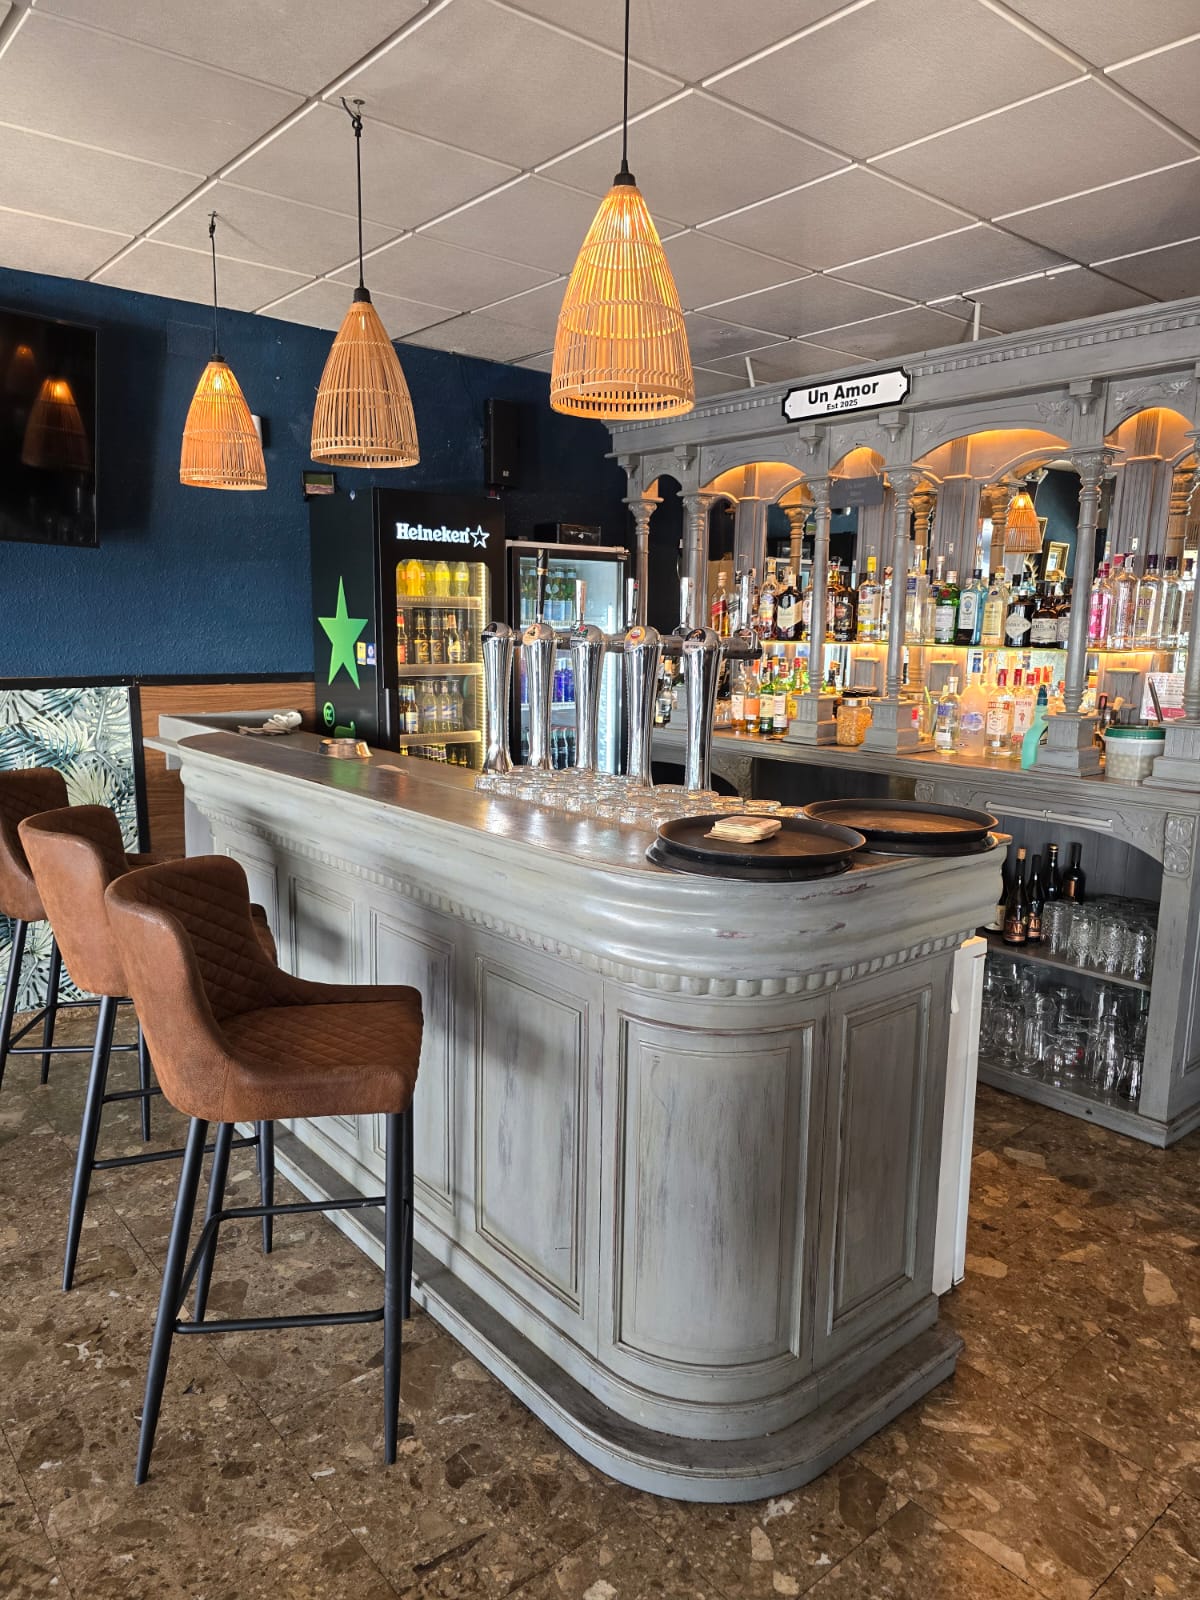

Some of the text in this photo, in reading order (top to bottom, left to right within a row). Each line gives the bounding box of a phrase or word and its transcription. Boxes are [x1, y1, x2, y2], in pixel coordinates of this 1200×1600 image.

[808, 382, 880, 405] Un Amor
[826, 399, 858, 411] Est 2025
[395, 522, 471, 544] Heineken
